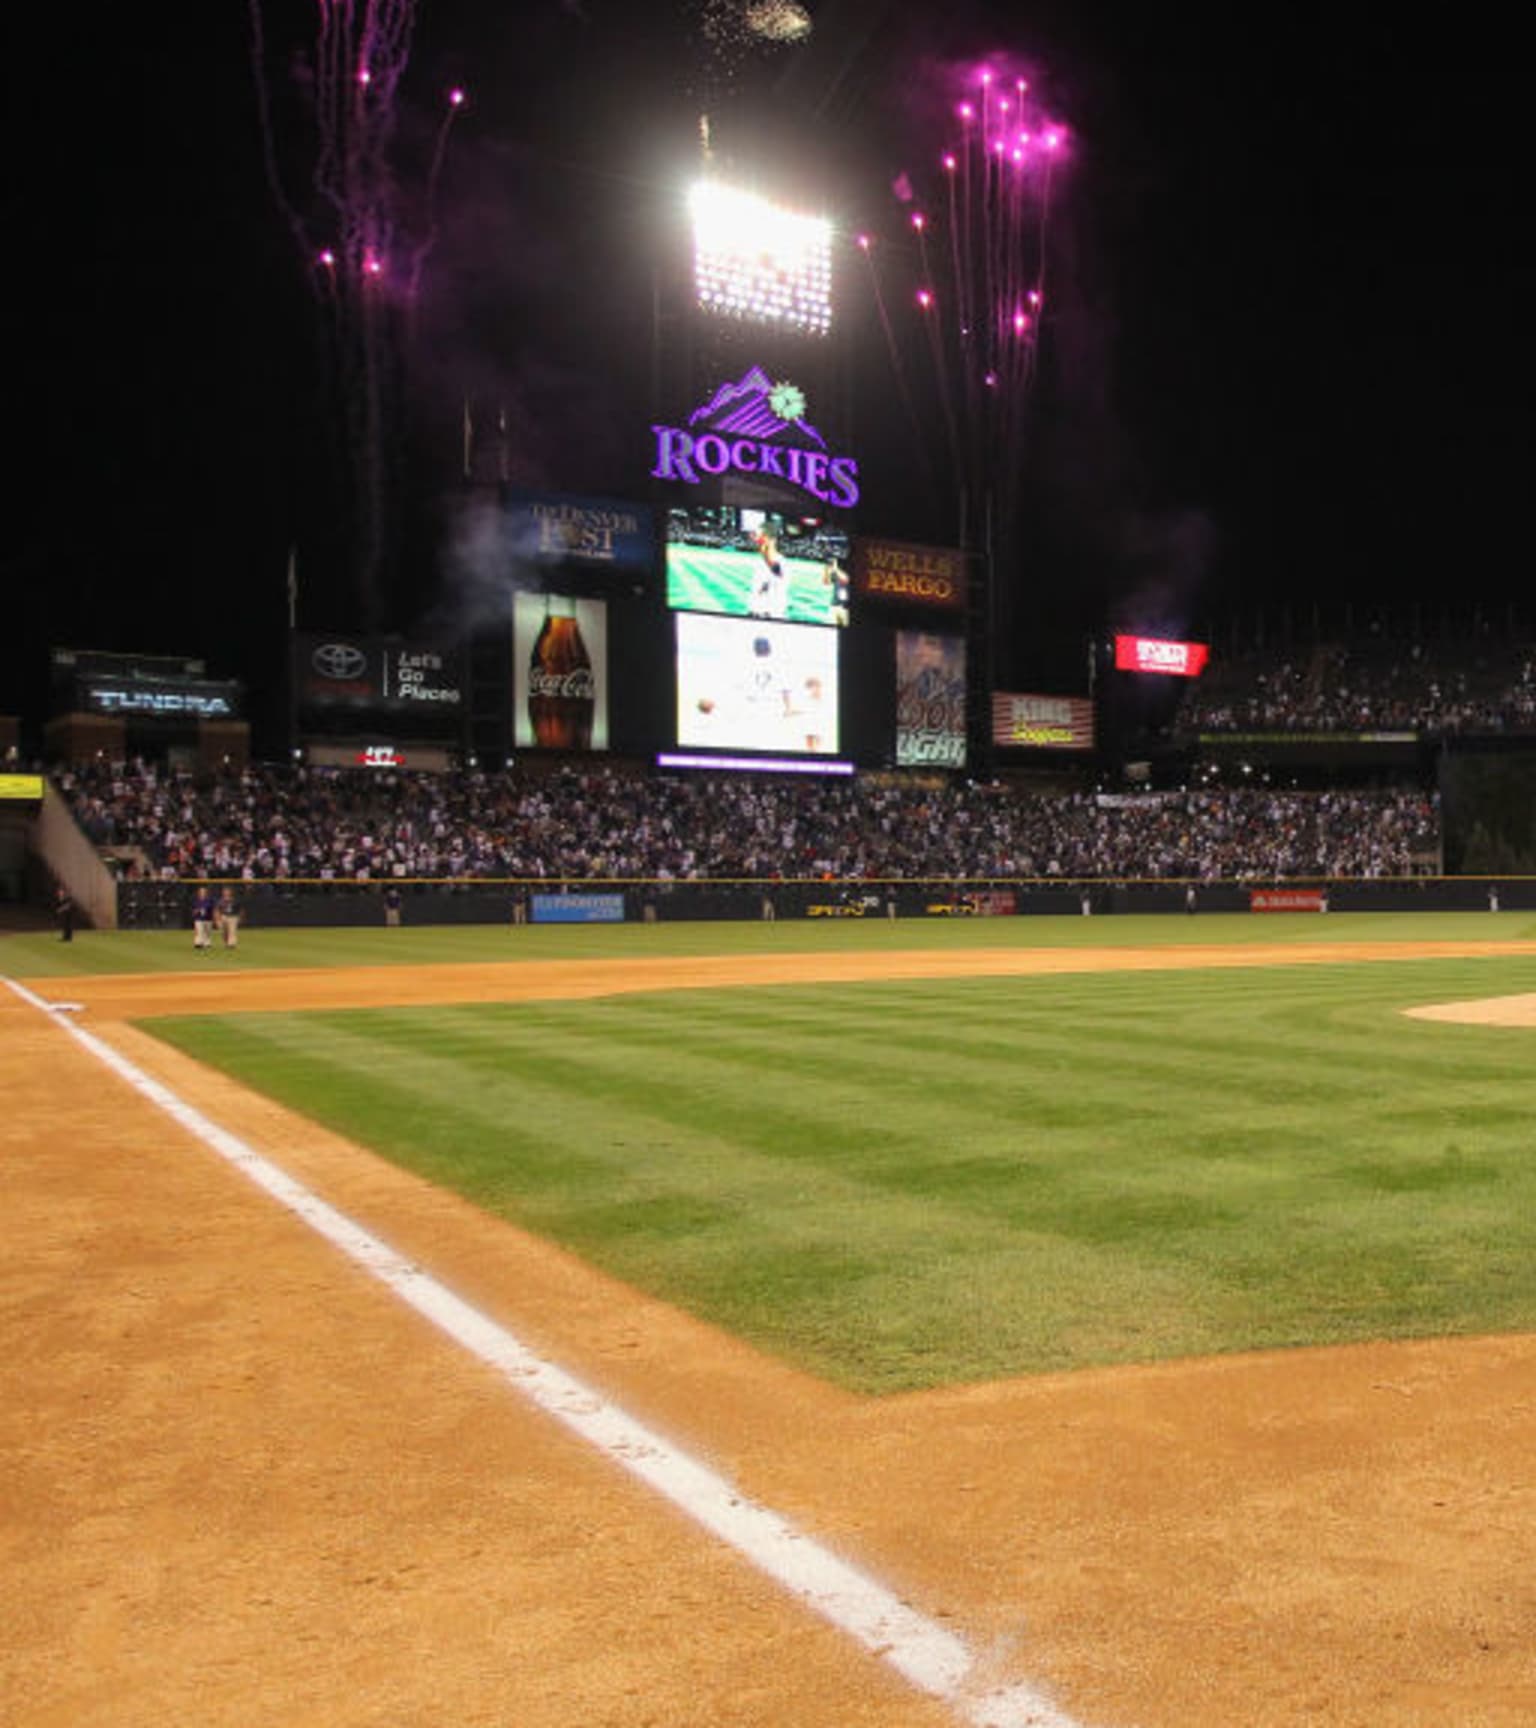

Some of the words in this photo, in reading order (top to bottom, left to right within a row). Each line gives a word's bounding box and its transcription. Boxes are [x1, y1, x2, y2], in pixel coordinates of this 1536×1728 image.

[651, 424, 860, 508] ROCKIES
[868, 550, 952, 575] WELLS
[868, 570, 952, 598] FARGO
[398, 668, 424, 682] Go
[91, 689, 231, 713] TUNDRA
[398, 683, 460, 703] Places
